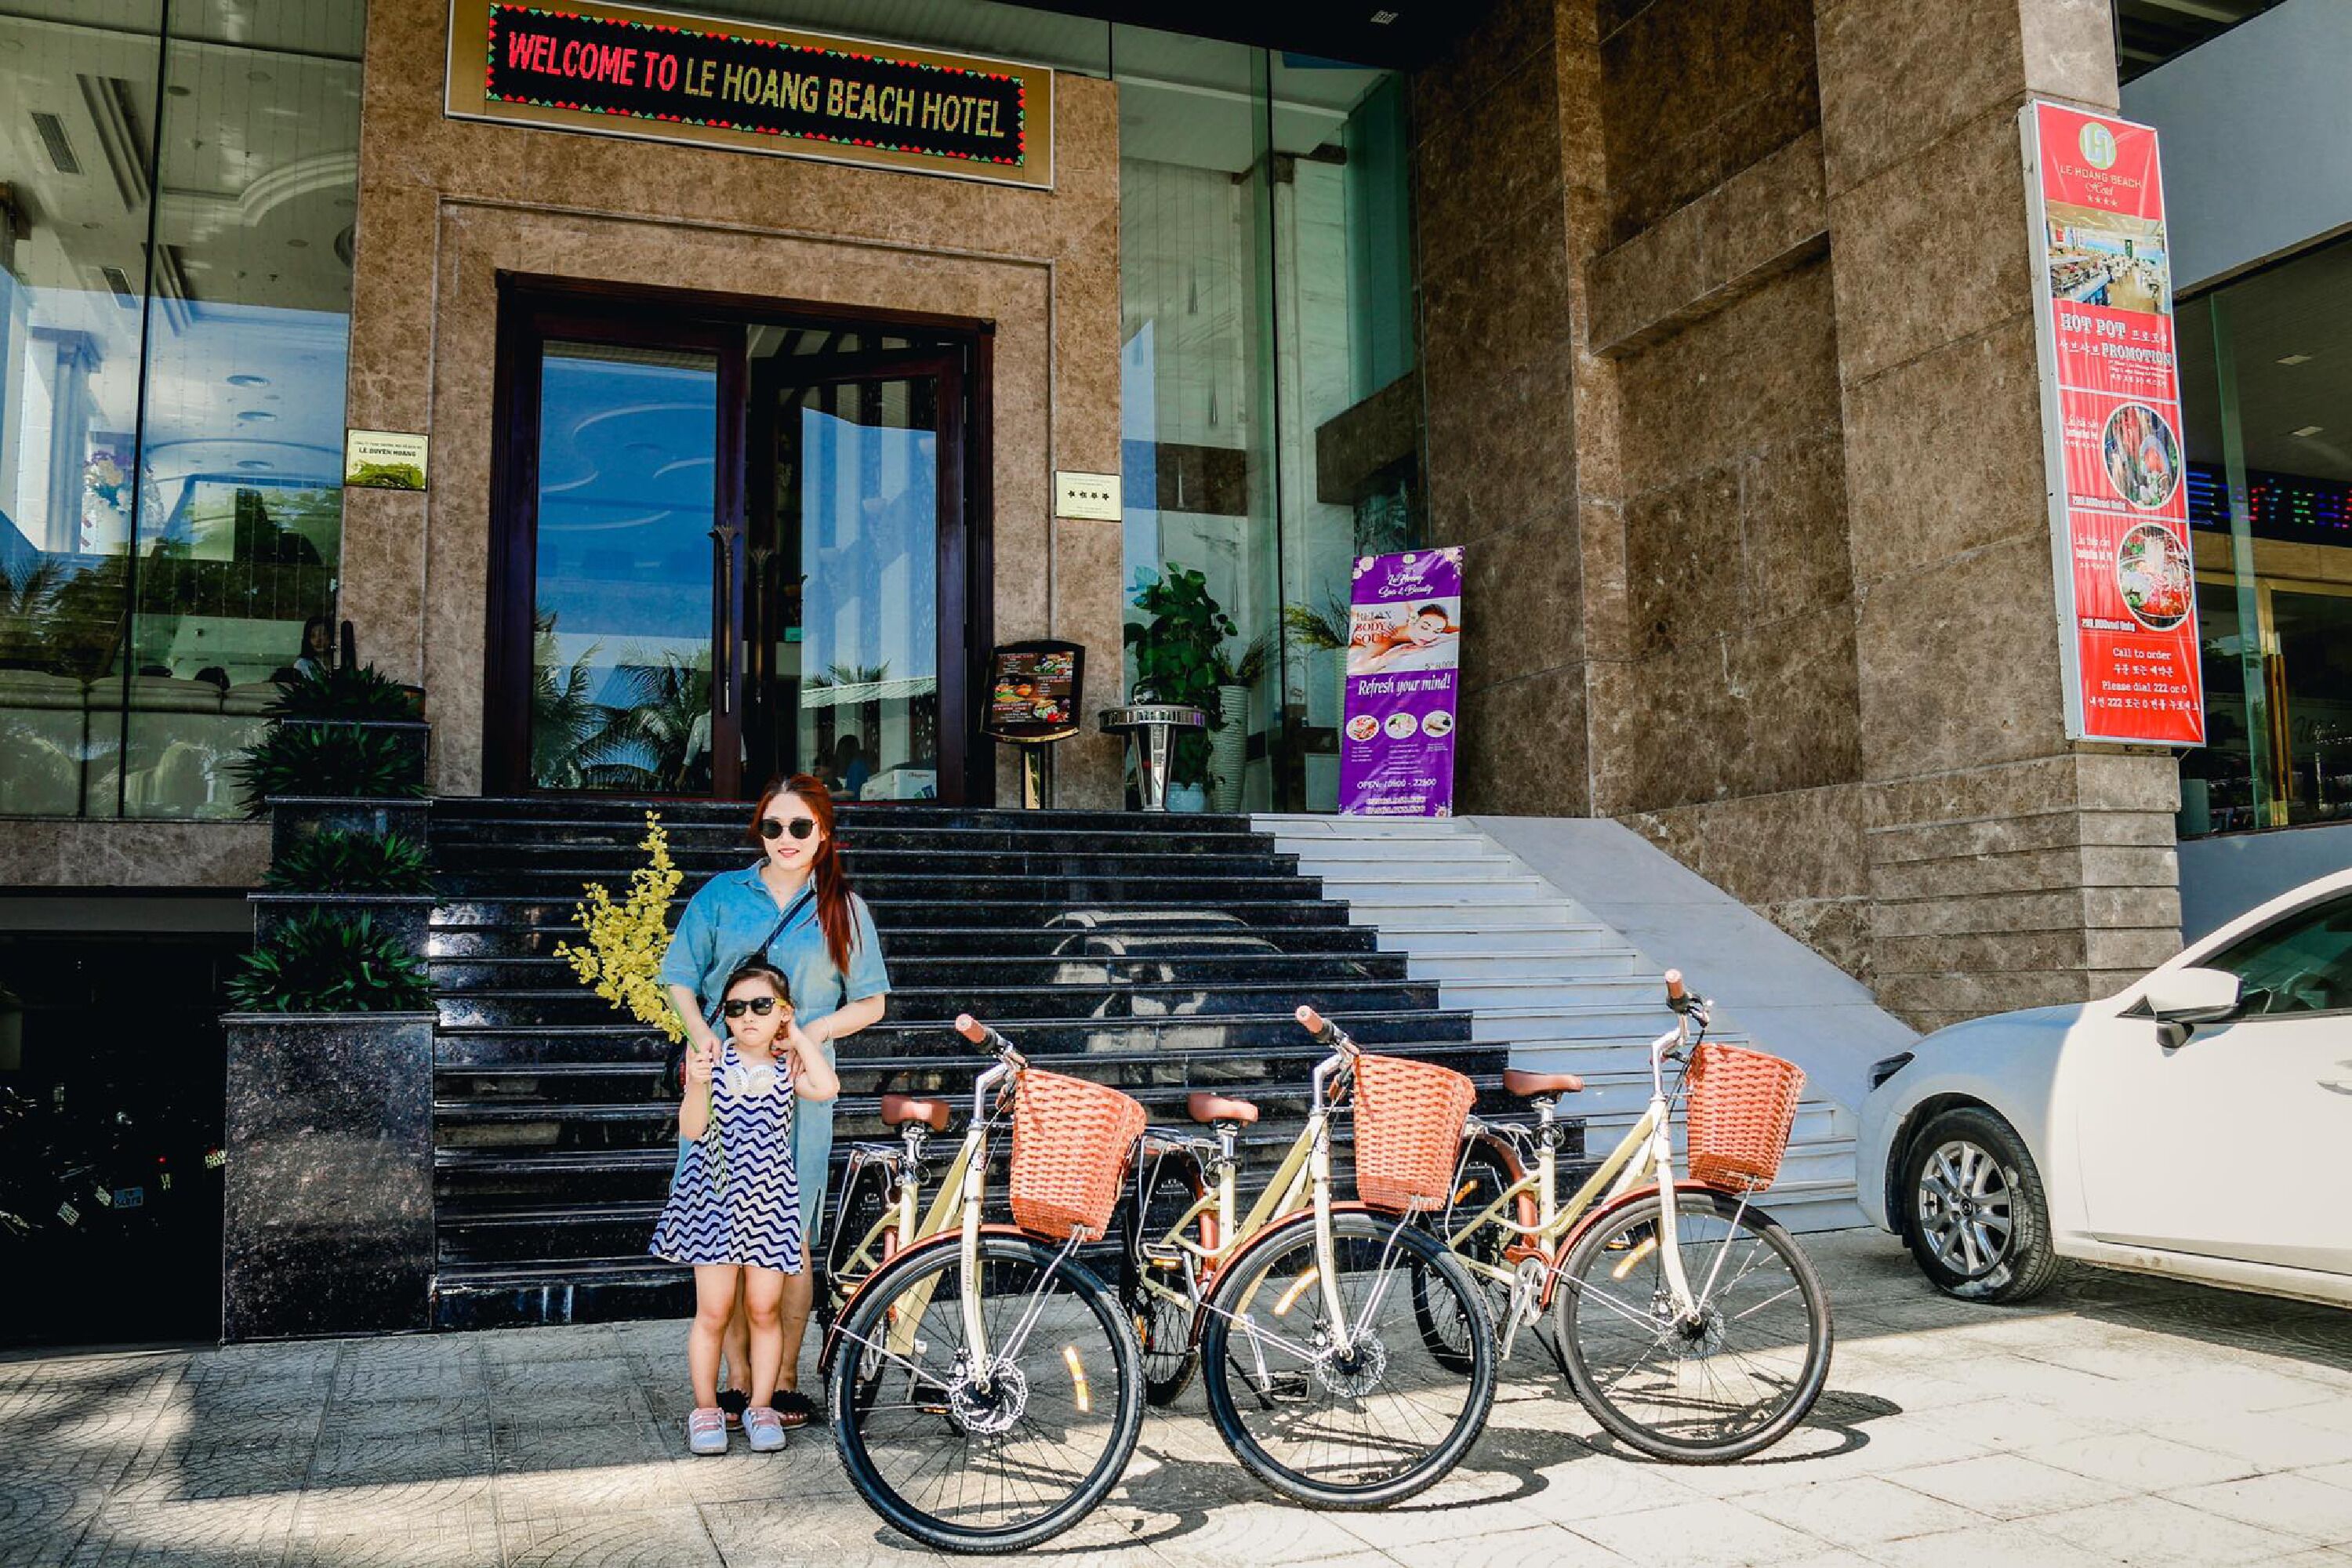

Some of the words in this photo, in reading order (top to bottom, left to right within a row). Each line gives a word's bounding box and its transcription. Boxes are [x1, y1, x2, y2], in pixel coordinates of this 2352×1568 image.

[508, 31, 636, 85] WELCOME
[644, 51, 677, 92] TO
[684, 58, 717, 96] LE
[723, 64, 820, 113] HOANG
[826, 78, 914, 126] BEACH
[921, 91, 1006, 137] HOTEL
[2060, 313, 2092, 334] HOT
[2096, 318, 2125, 339] POT
[2102, 342, 2172, 365] PROMOTION
[2113, 647, 2132, 658] Call
[2134, 649, 2144, 659] to
[2147, 651, 2172, 661] order
[1358, 676, 1394, 698] Refresh
[1396, 679, 1420, 696] your
[1421, 673, 1451, 691] mind!
[2102, 680, 2132, 691] Please
[2133, 682, 2151, 693] dial
[2154, 683, 2169, 693] 222
